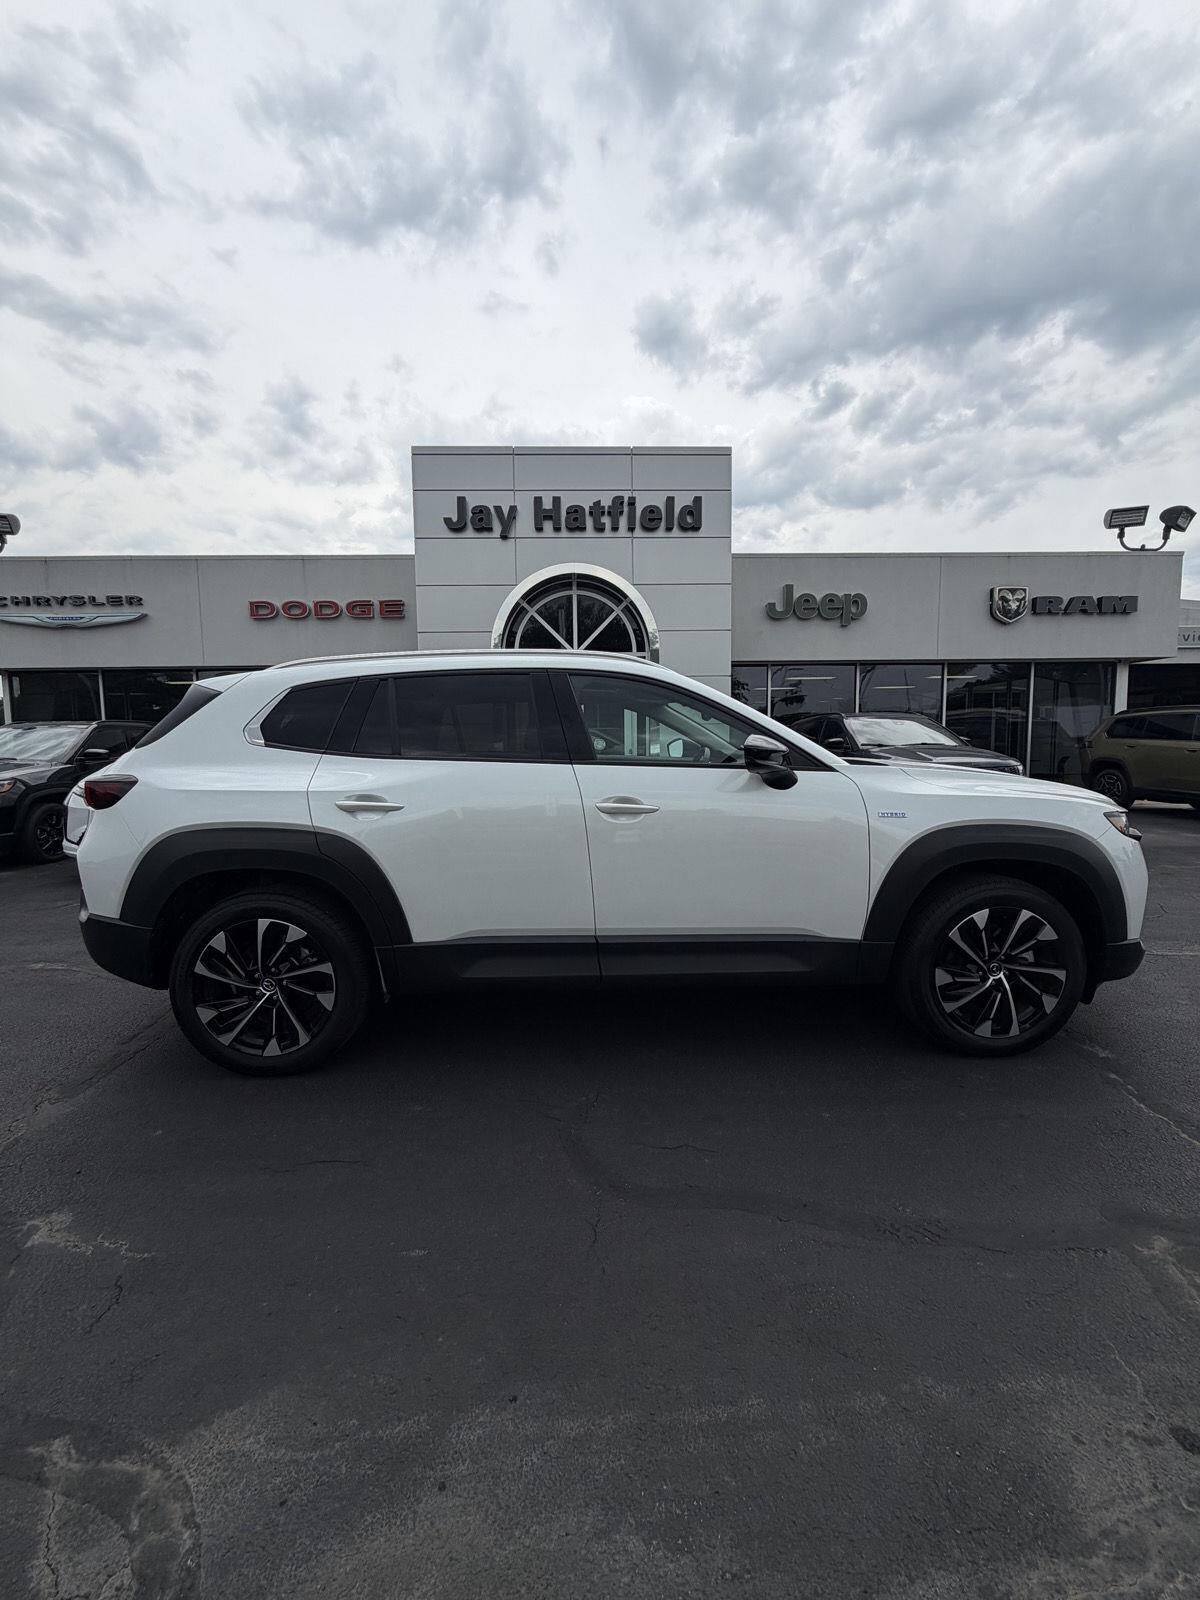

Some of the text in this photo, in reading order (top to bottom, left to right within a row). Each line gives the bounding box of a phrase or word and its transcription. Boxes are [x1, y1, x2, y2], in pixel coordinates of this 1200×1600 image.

[443, 496, 703, 540] Jay Hatfield
[248, 600, 406, 620] DODGE
[765, 584, 868, 626] Jeep
[1031, 595, 1139, 615] RAM
[880, 810, 907, 818] HYBRID
